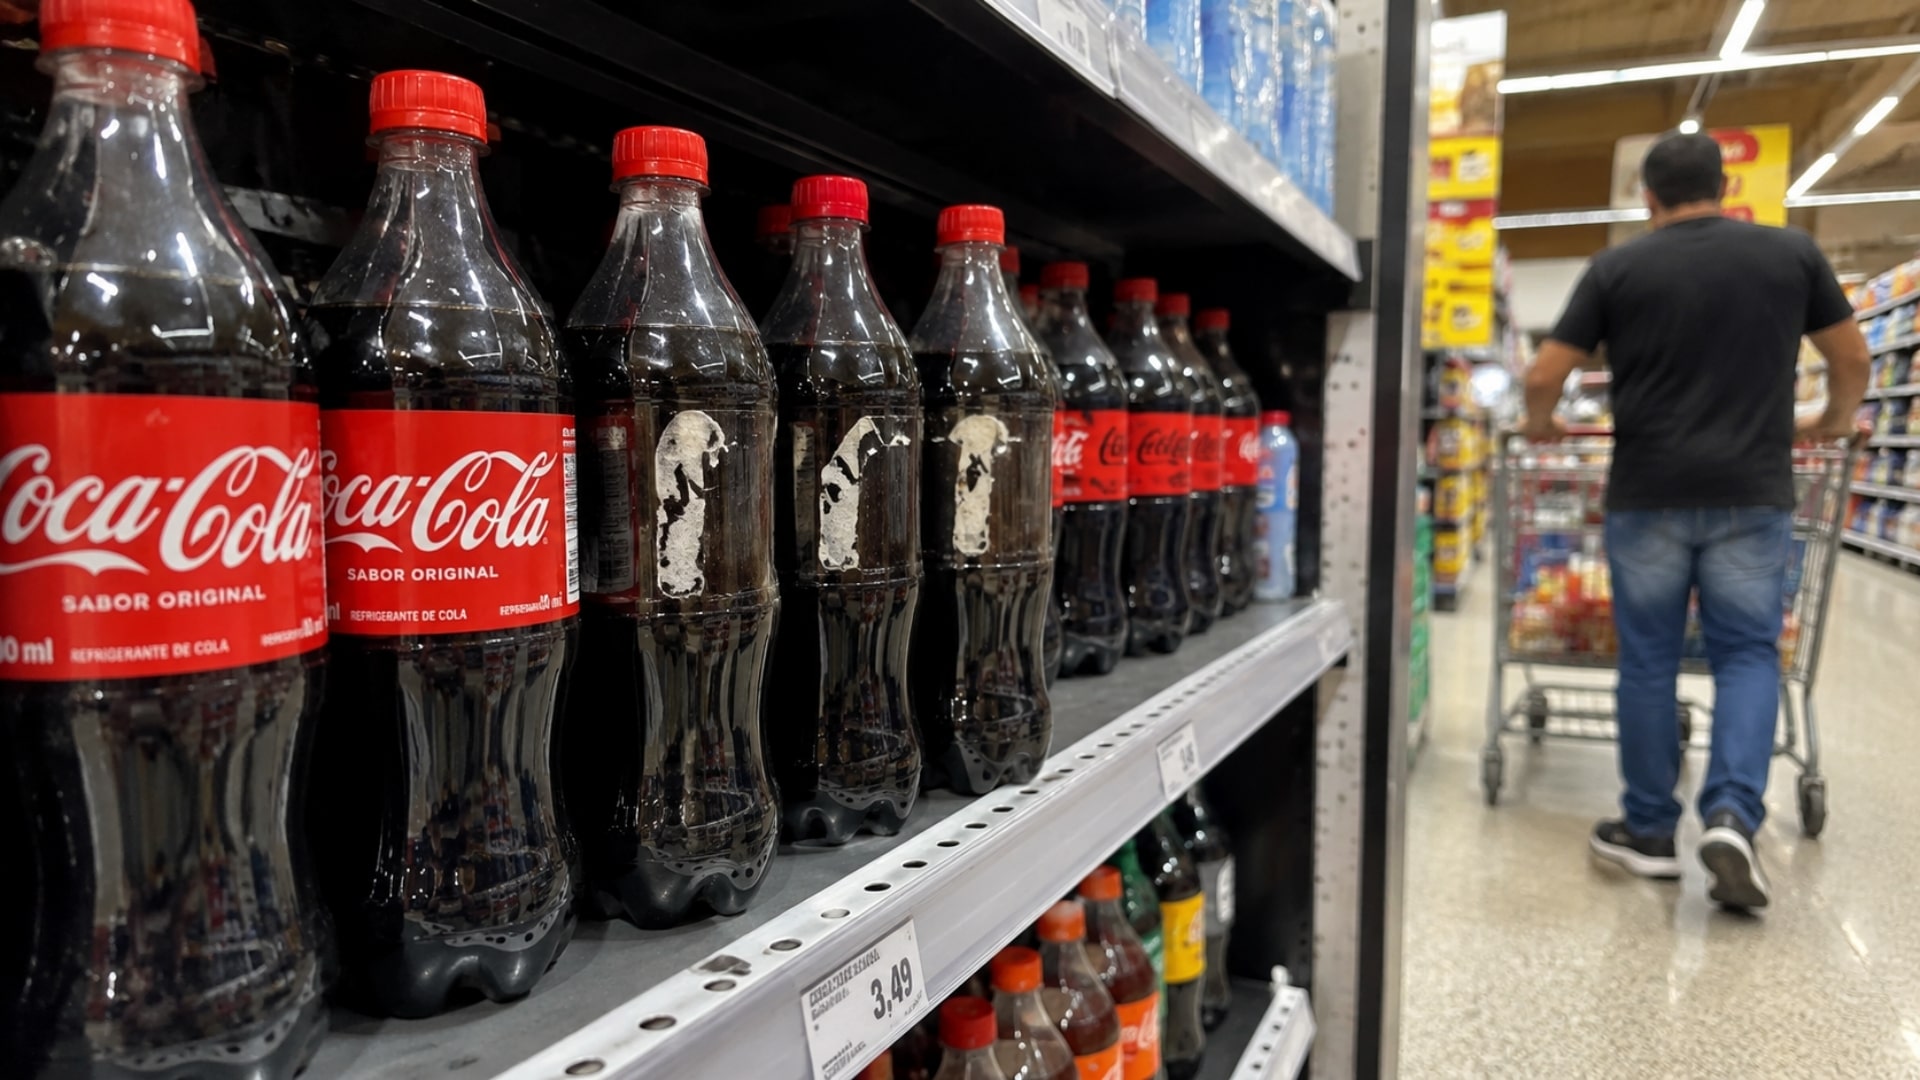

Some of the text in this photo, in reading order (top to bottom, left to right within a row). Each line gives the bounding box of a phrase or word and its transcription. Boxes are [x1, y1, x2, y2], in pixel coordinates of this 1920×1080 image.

[347, 565, 499, 582] SABOR ORIGINAL
[61, 585, 267, 613] SABOR ORIGINAL
[350, 608, 467, 622] REFRIGERANTE DE COLA
[0, 635, 54, 665] 0 ml
[70, 638, 230, 664] REFRIGERANTE DE COLA
